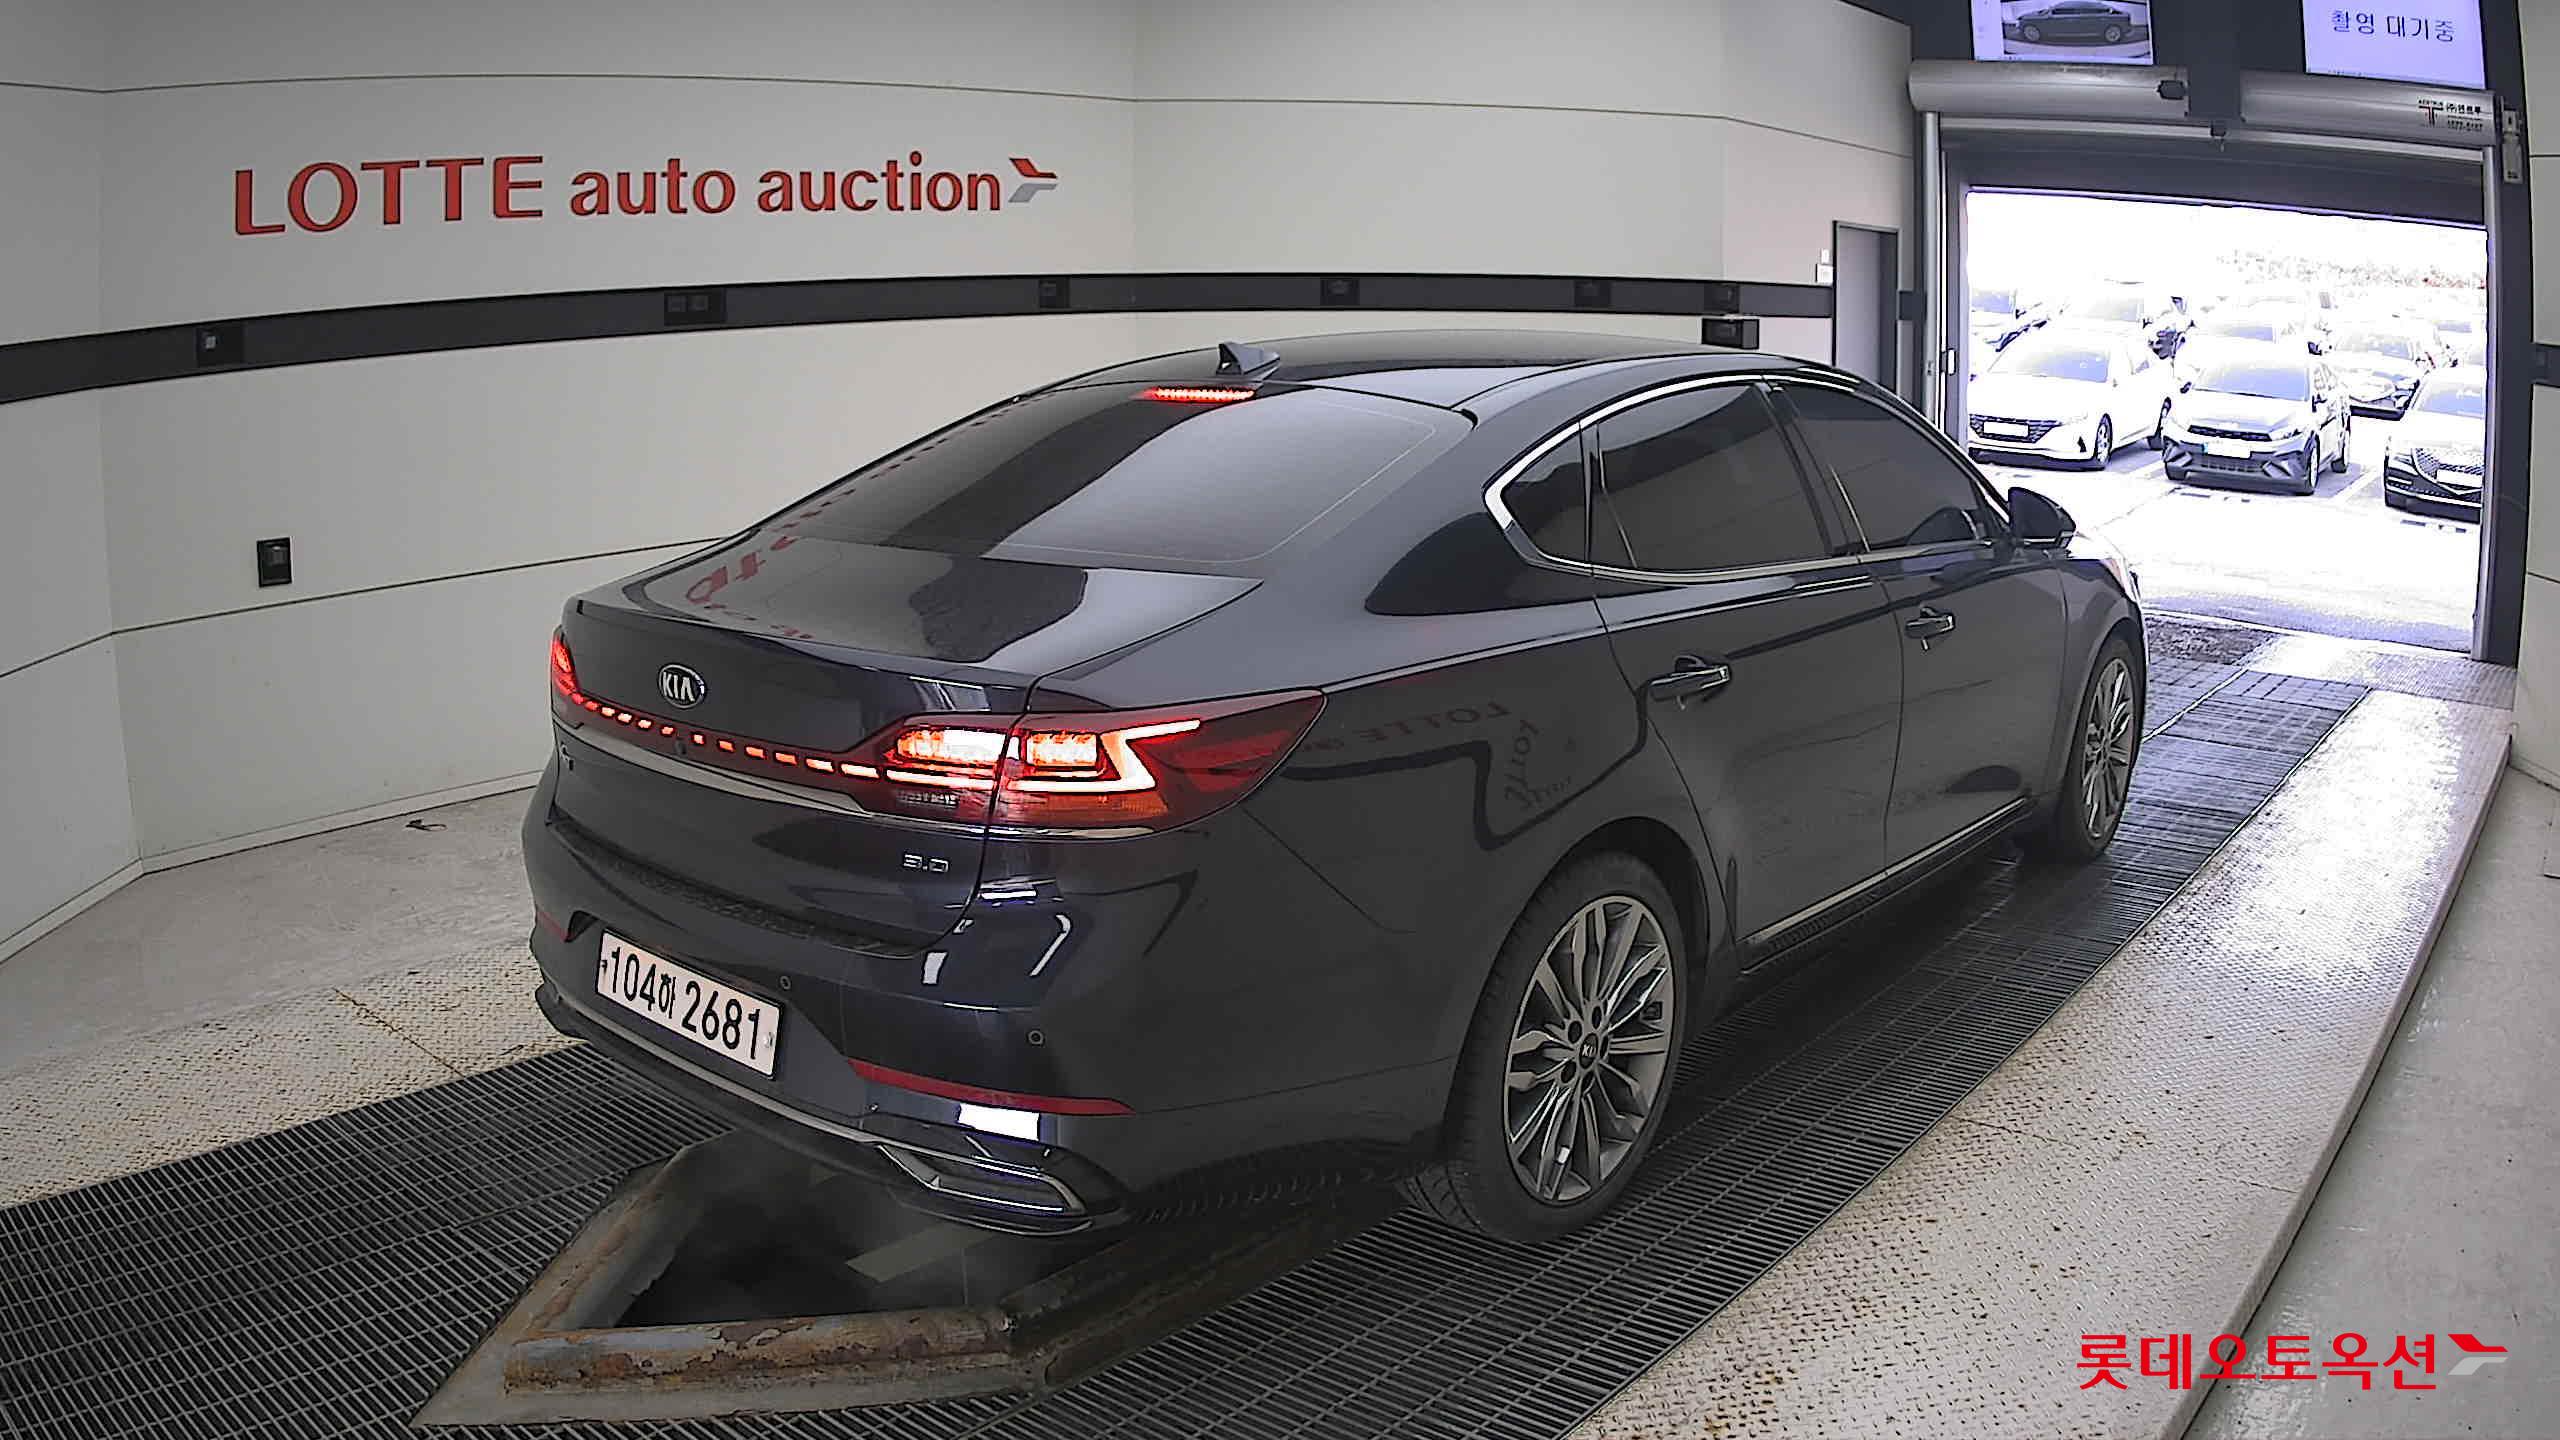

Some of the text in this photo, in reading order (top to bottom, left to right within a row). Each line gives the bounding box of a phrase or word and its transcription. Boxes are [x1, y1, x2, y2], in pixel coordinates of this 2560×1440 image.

[2387, 15, 2455, 42] 대기중
[234, 150, 1002, 236] LOTTE auto auction
[662, 671, 696, 702] KIA
[611, 945, 761, 1061] 104하 2681
